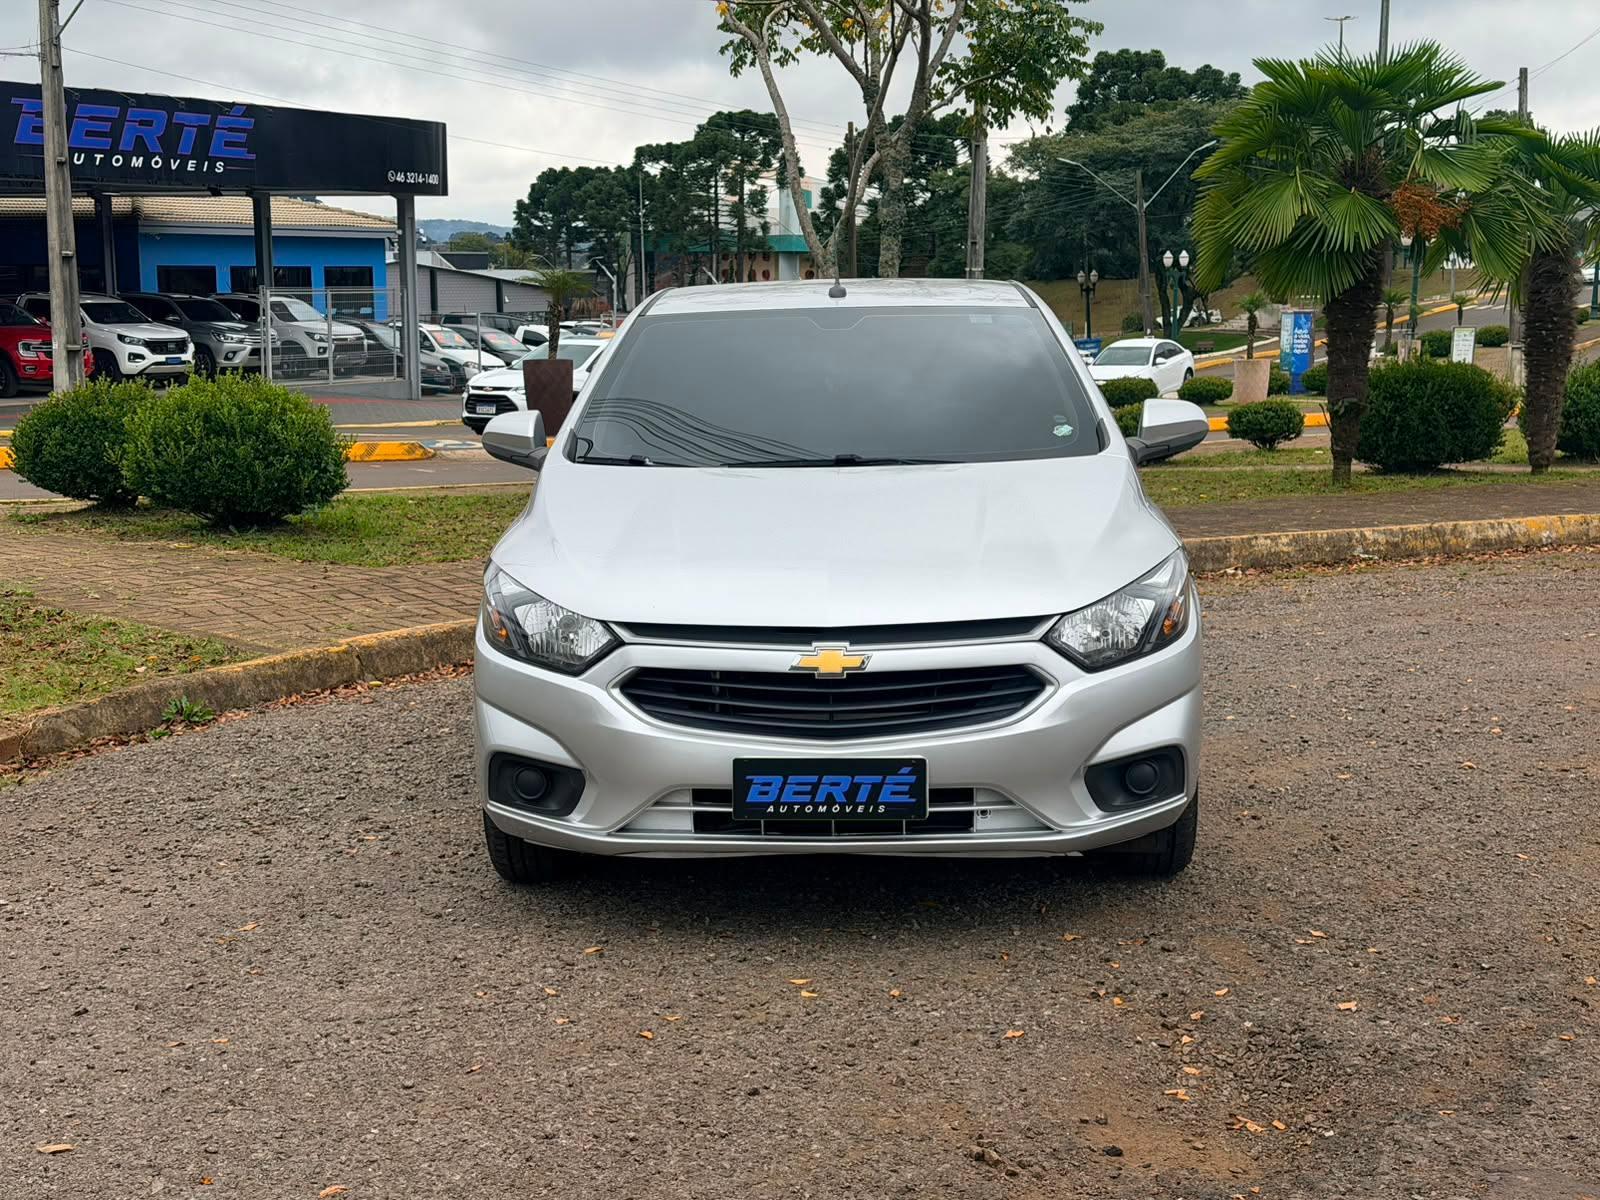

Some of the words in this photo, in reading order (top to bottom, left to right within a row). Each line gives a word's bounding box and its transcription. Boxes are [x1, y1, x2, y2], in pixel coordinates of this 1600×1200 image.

[73, 152, 225, 173] UTOMÓVEIS
[396, 171, 405, 183] 46
[406, 172, 439, 185] 3214-1400
[745, 767, 917, 802] BERTÉ
[766, 805, 886, 813] AUTOMÓVEIS
